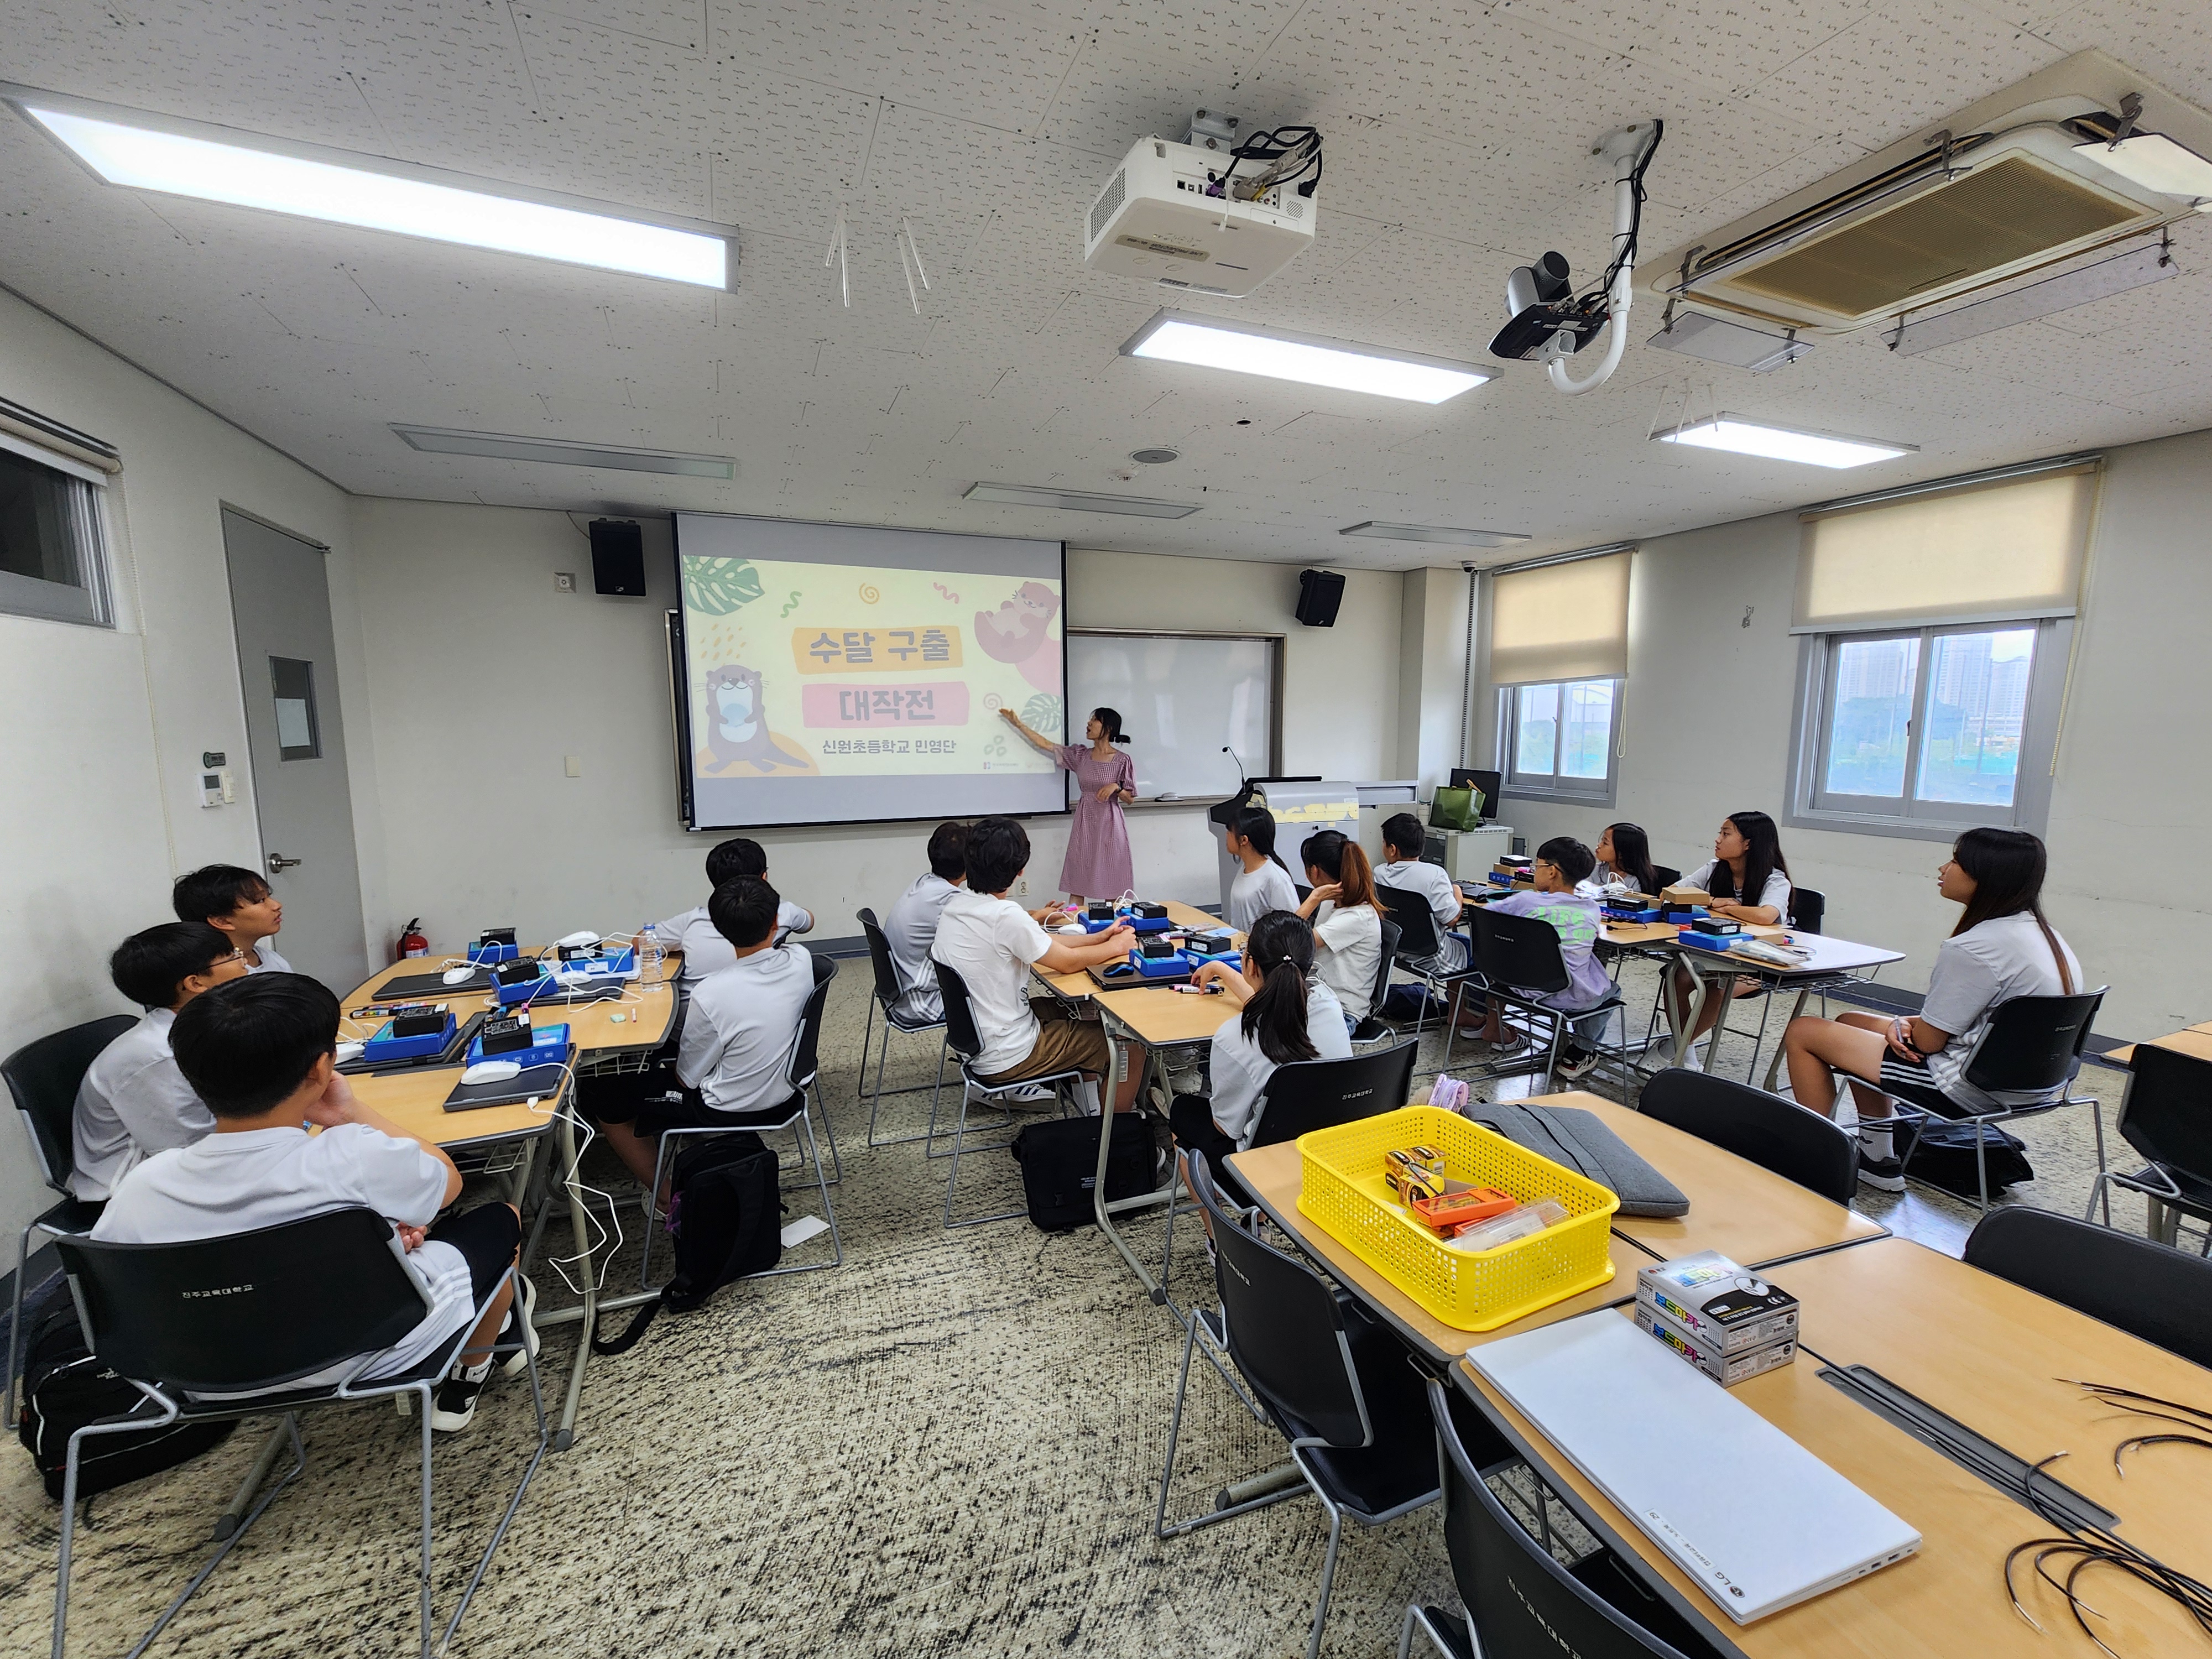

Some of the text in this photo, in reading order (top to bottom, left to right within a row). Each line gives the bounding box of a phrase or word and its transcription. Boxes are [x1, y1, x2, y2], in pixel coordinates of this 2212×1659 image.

[809, 629, 950, 664] 수달 구출
[839, 690, 936, 721] 대작전
[822, 740, 957, 754] 신원초등학교 민영단
[182, 1284, 254, 1298] 진주교육대학교
[1655, 1291, 1699, 1332] 보드마카
[1652, 1323, 1699, 1364] 보드마카
[1649, 1512, 1660, 1520] 29
[1714, 1572, 1732, 1585] LG
